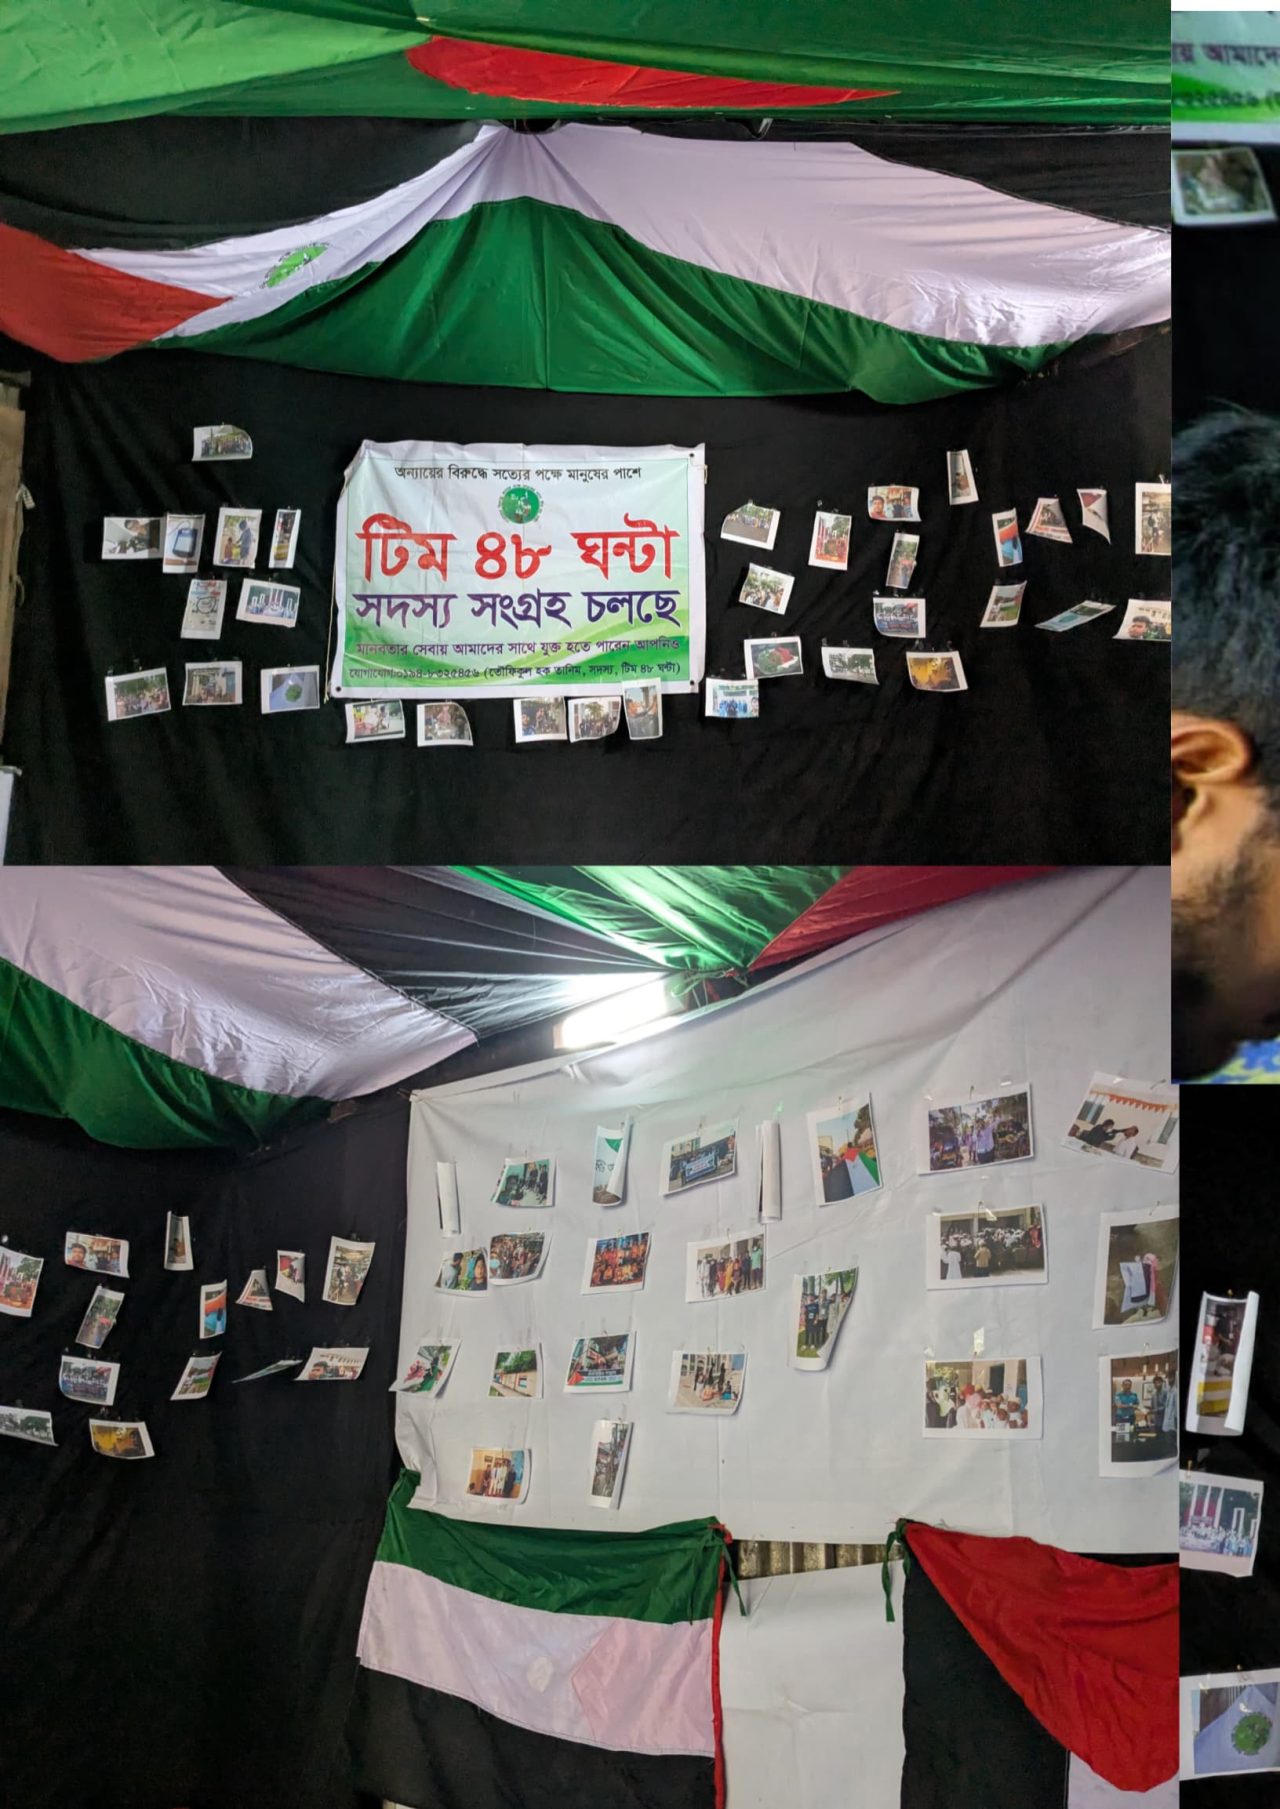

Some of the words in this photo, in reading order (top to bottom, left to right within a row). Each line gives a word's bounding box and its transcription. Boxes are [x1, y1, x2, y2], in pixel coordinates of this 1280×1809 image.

[395, 466, 443, 481] অন্যায়ের
[448, 464, 488, 480] বিরুদ্ধে
[493, 467, 530, 481] সত্যের
[535, 467, 562, 481] পক্ষে
[567, 467, 609, 483] মানুষের
[613, 466, 641, 480] পাশে
[355, 512, 457, 582] টিম
[474, 532, 552, 580] ৪৮
[570, 512, 680, 580] ঘন্টা
[352, 593, 457, 628] সদস্য
[467, 588, 572, 629] সংগ্রহ
[581, 590, 681, 627] চলছে
[357, 643, 408, 656] মানবতার
[413, 643, 448, 656] সেবায়
[452, 642, 503, 655] আমাদের
[508, 641, 536, 654] সাথে
[540, 641, 561, 656] যুক্ত
[566, 641, 591, 654] হতে
[596, 639, 630, 653] পারেন
[634, 635, 680, 650] আপনিও
[536, 666, 551, 676] হক
[621, 661, 637, 674] টিম
[640, 664, 653, 674] ৪৮
